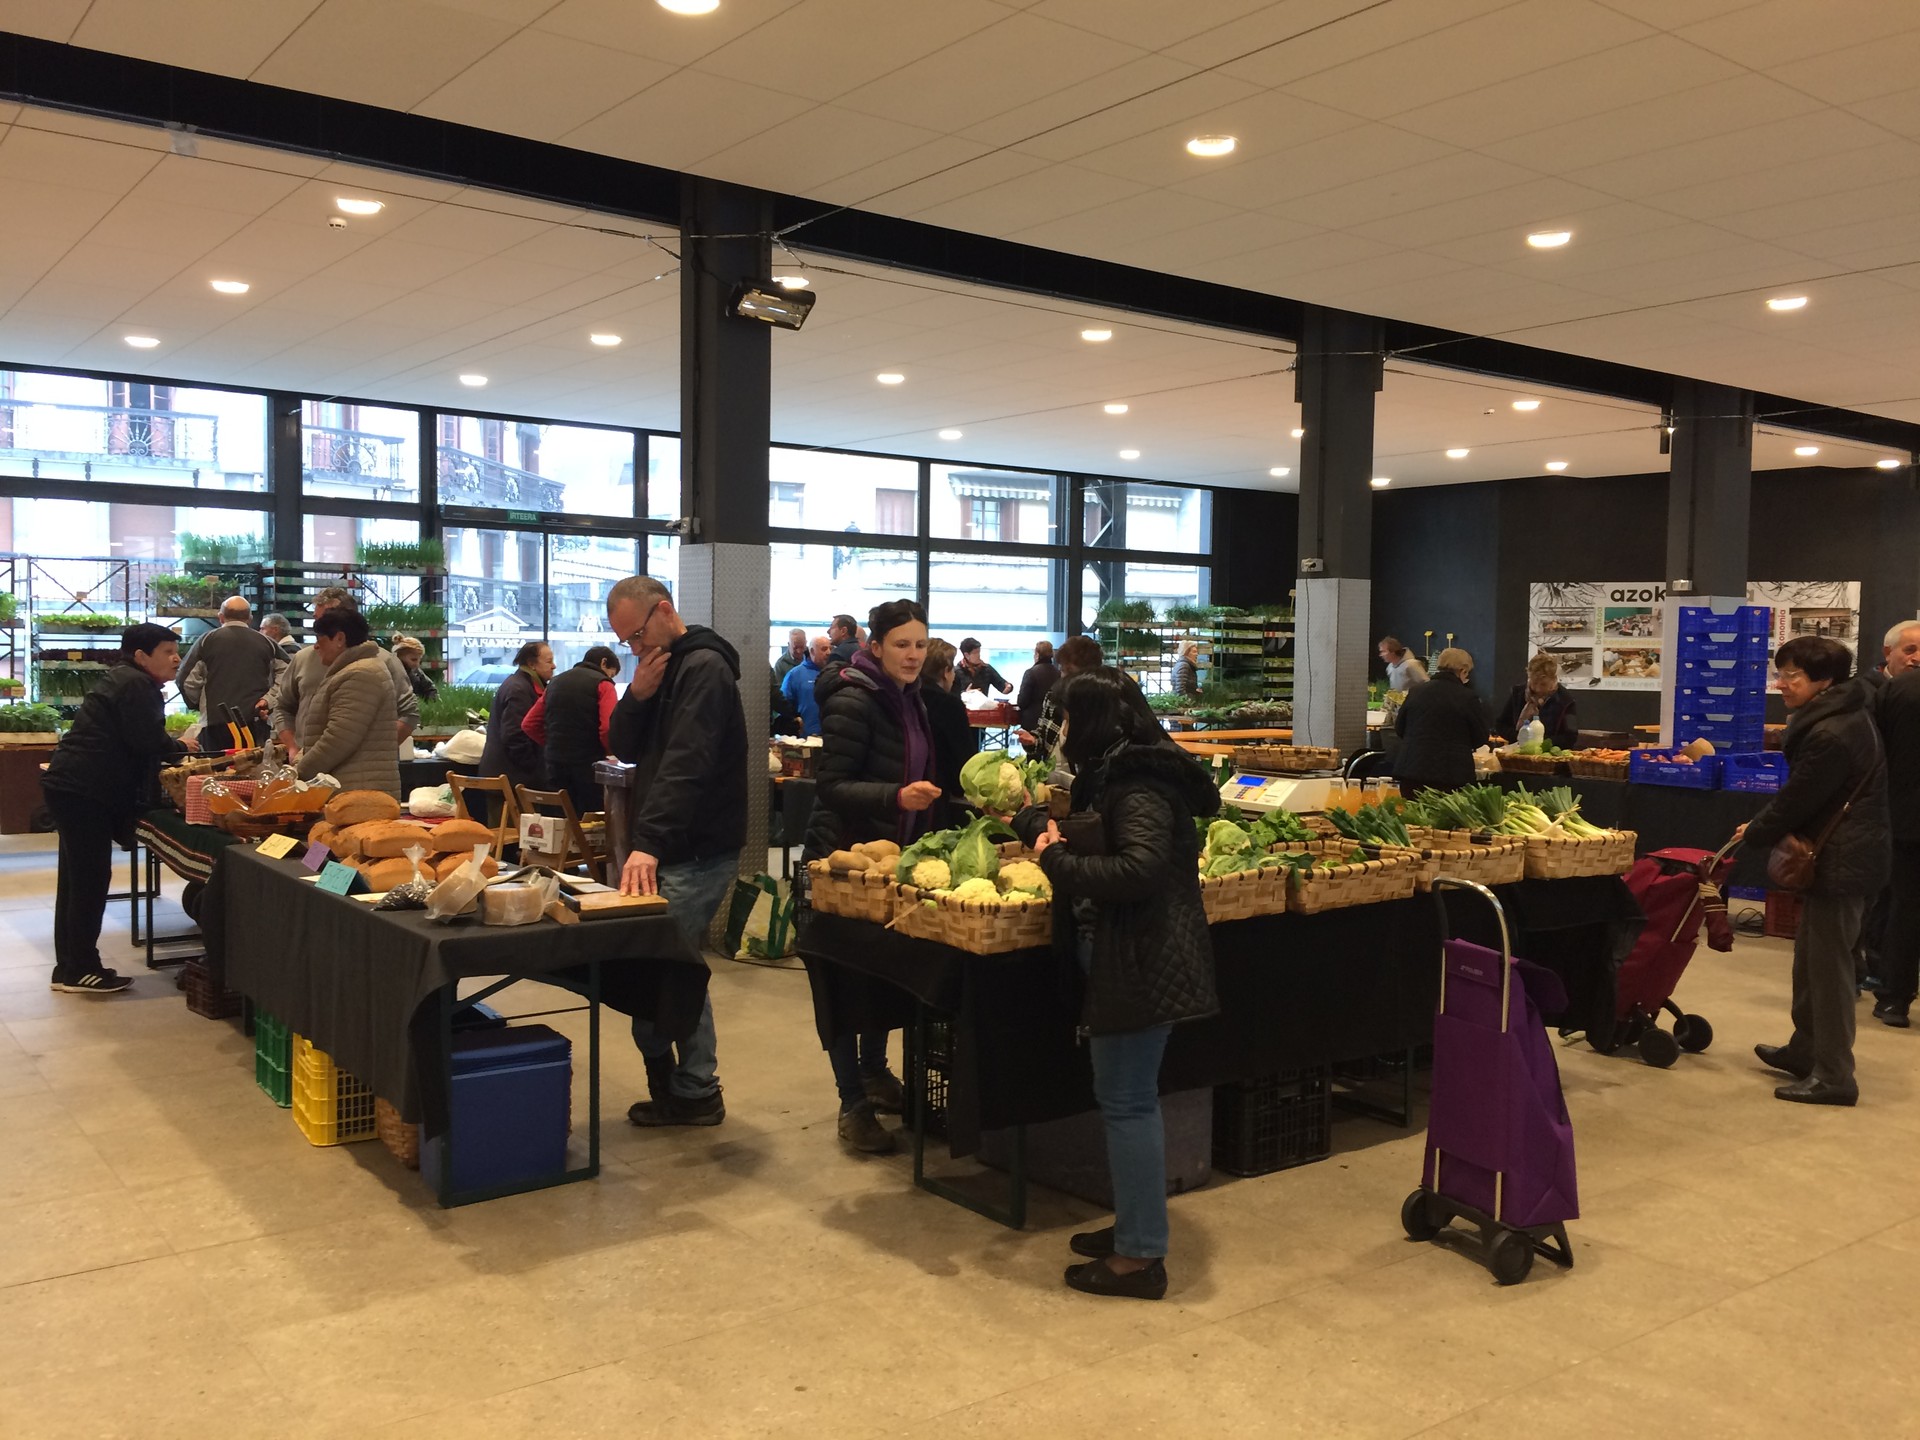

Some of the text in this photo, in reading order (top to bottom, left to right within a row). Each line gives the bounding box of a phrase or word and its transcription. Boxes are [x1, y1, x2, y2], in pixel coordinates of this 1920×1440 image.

[509, 511, 537, 521] IRTEERA
[1610, 586, 1666, 602] azok
[1778, 609, 1786, 647] konomia
